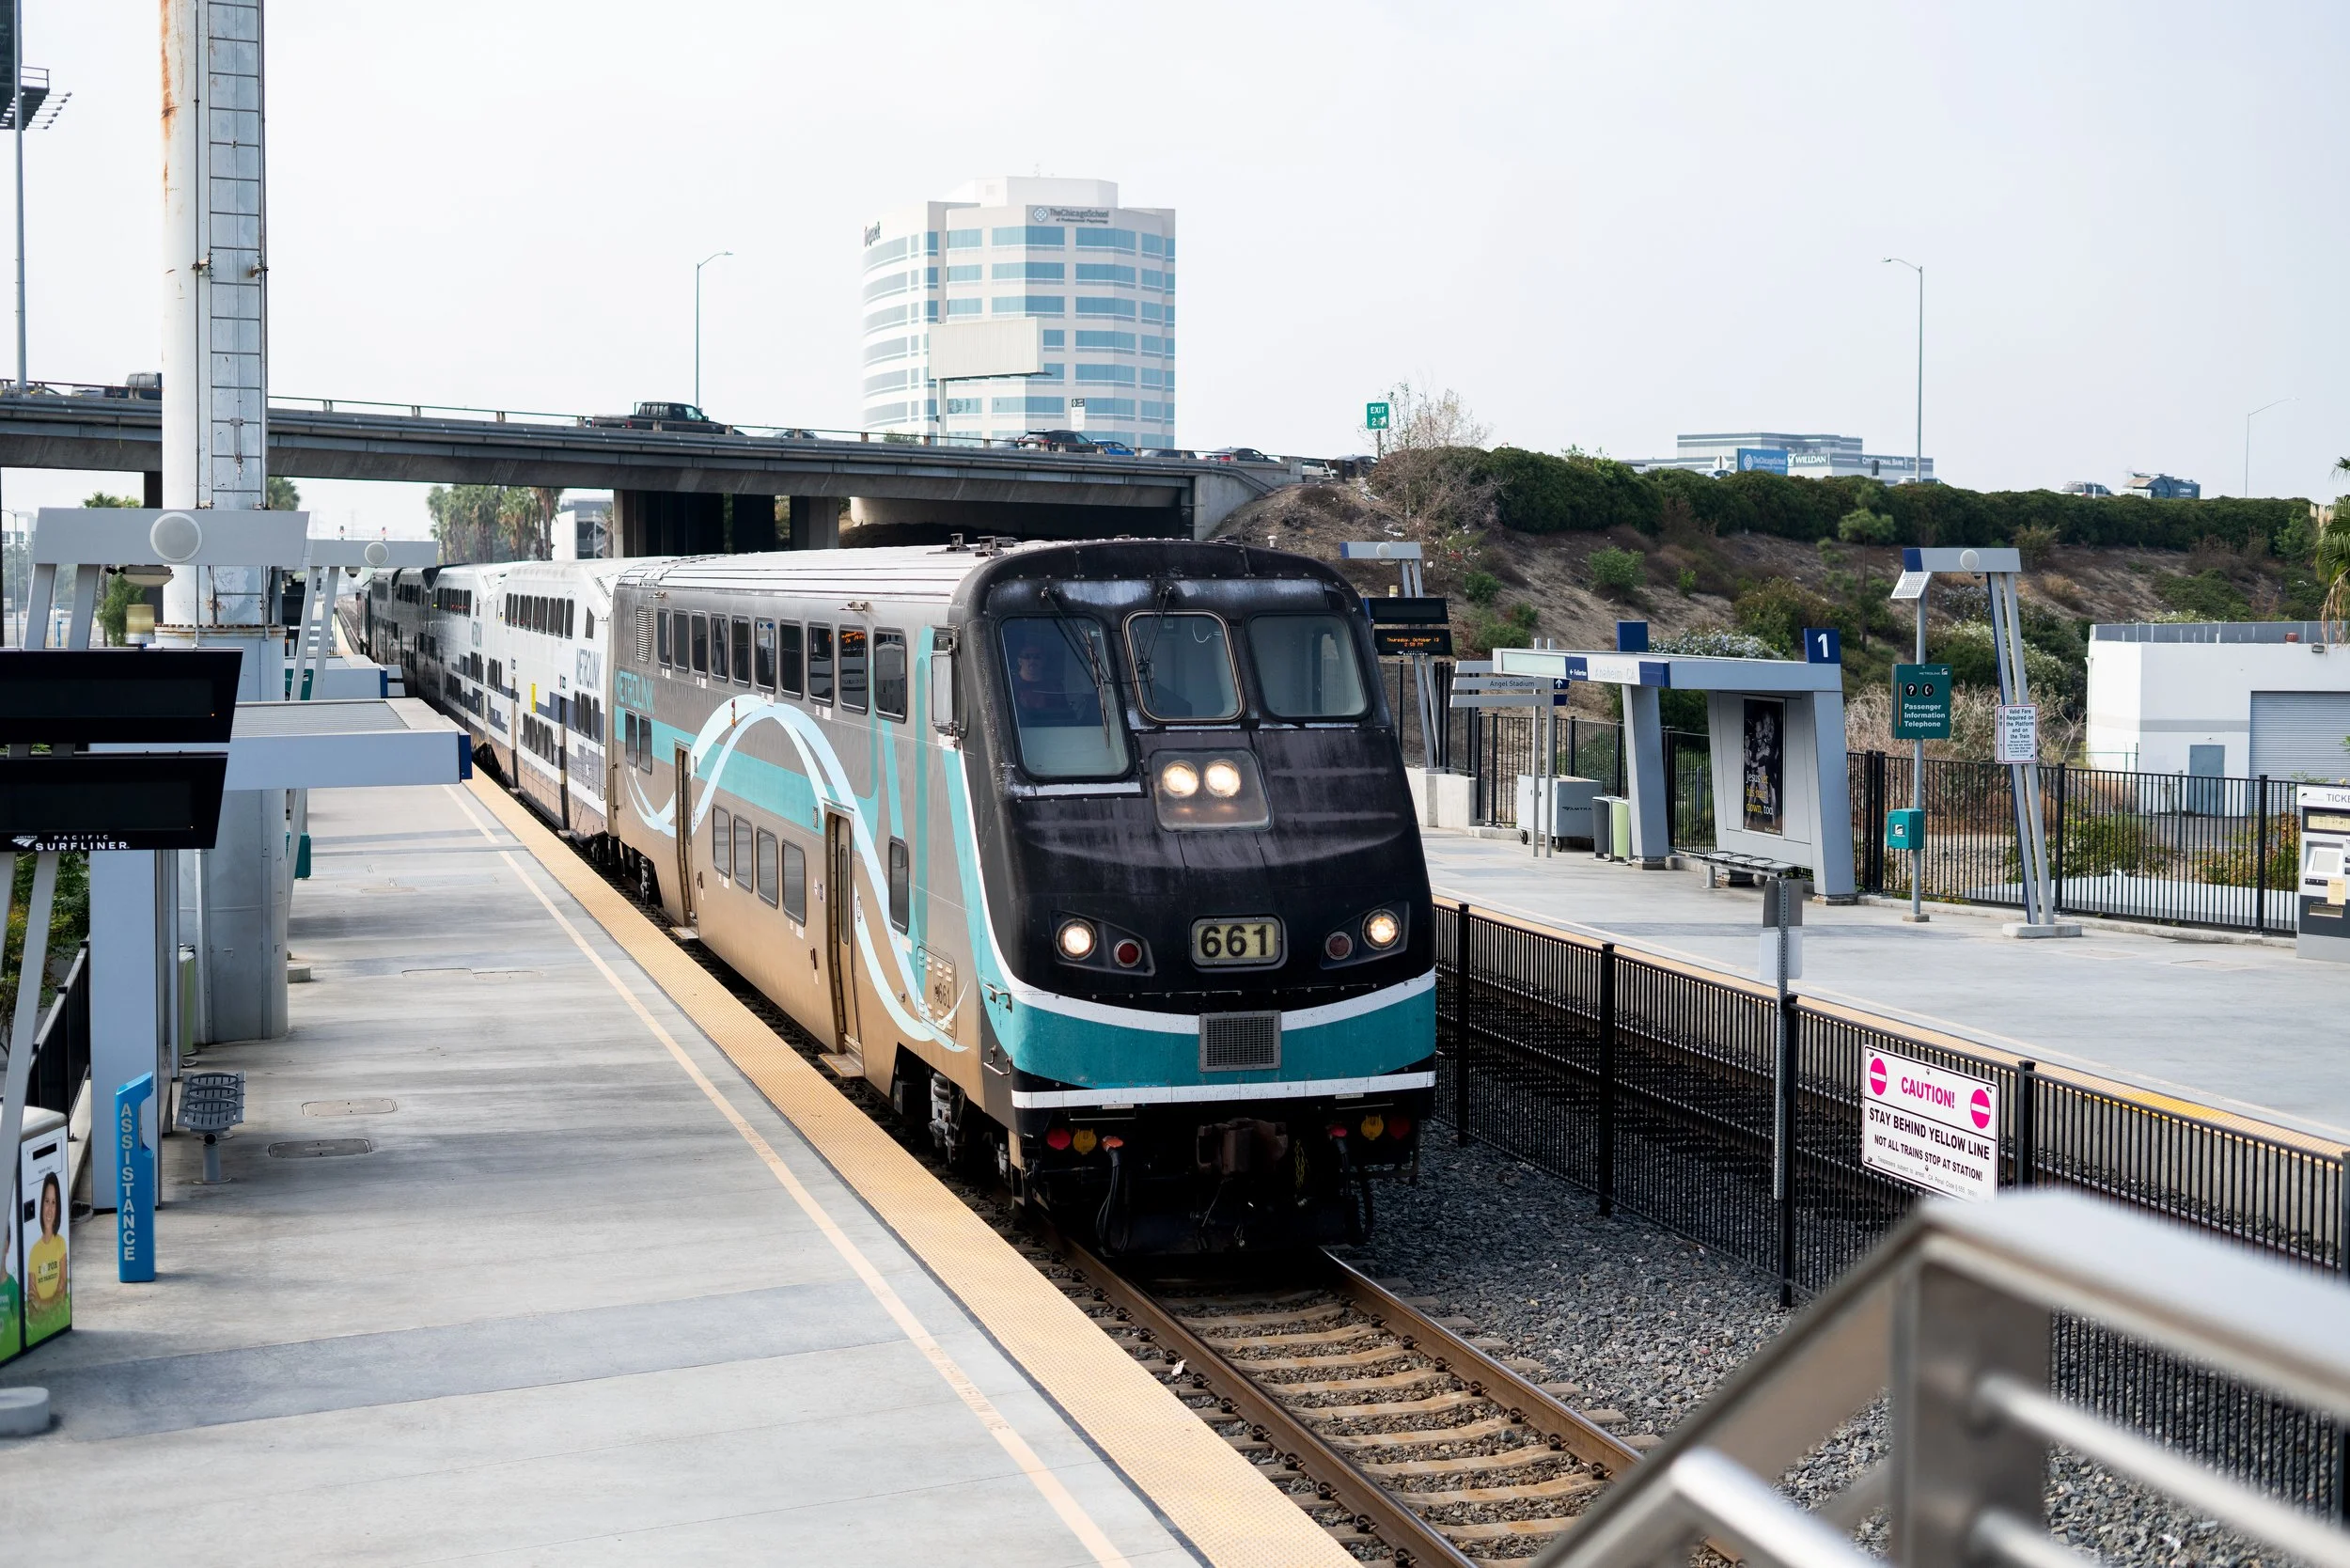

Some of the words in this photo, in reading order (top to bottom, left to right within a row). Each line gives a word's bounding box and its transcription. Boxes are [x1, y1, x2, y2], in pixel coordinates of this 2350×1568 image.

[1795, 455, 1826, 464] WILLDAN
[1817, 634, 1829, 658] 1
[1904, 703, 1942, 712] Passenger
[1904, 720, 1941, 729] Telephone
[1746, 771, 1761, 784] Jesus
[35, 841, 128, 851] SURFLINER
[1200, 924, 1267, 958] 661
[1901, 1076, 1955, 1109] CAUTION!
[1869, 1107, 1891, 1126] STAY
[1893, 1116, 1926, 1138] BEHIND
[1928, 1126, 1966, 1152] YELLOW
[1967, 1140, 1990, 1160] LINE
[1874, 1134, 1887, 1147] NOT
[1888, 1139, 1899, 1152] ALL
[1900, 1143, 1923, 1160] TRAINS
[1924, 1152, 1941, 1167] STOP
[1942, 1158, 1951, 1170] AT
[1951, 1161, 1983, 1182] STATION!
[120, 1103, 135, 1262] ASSISTANCE
